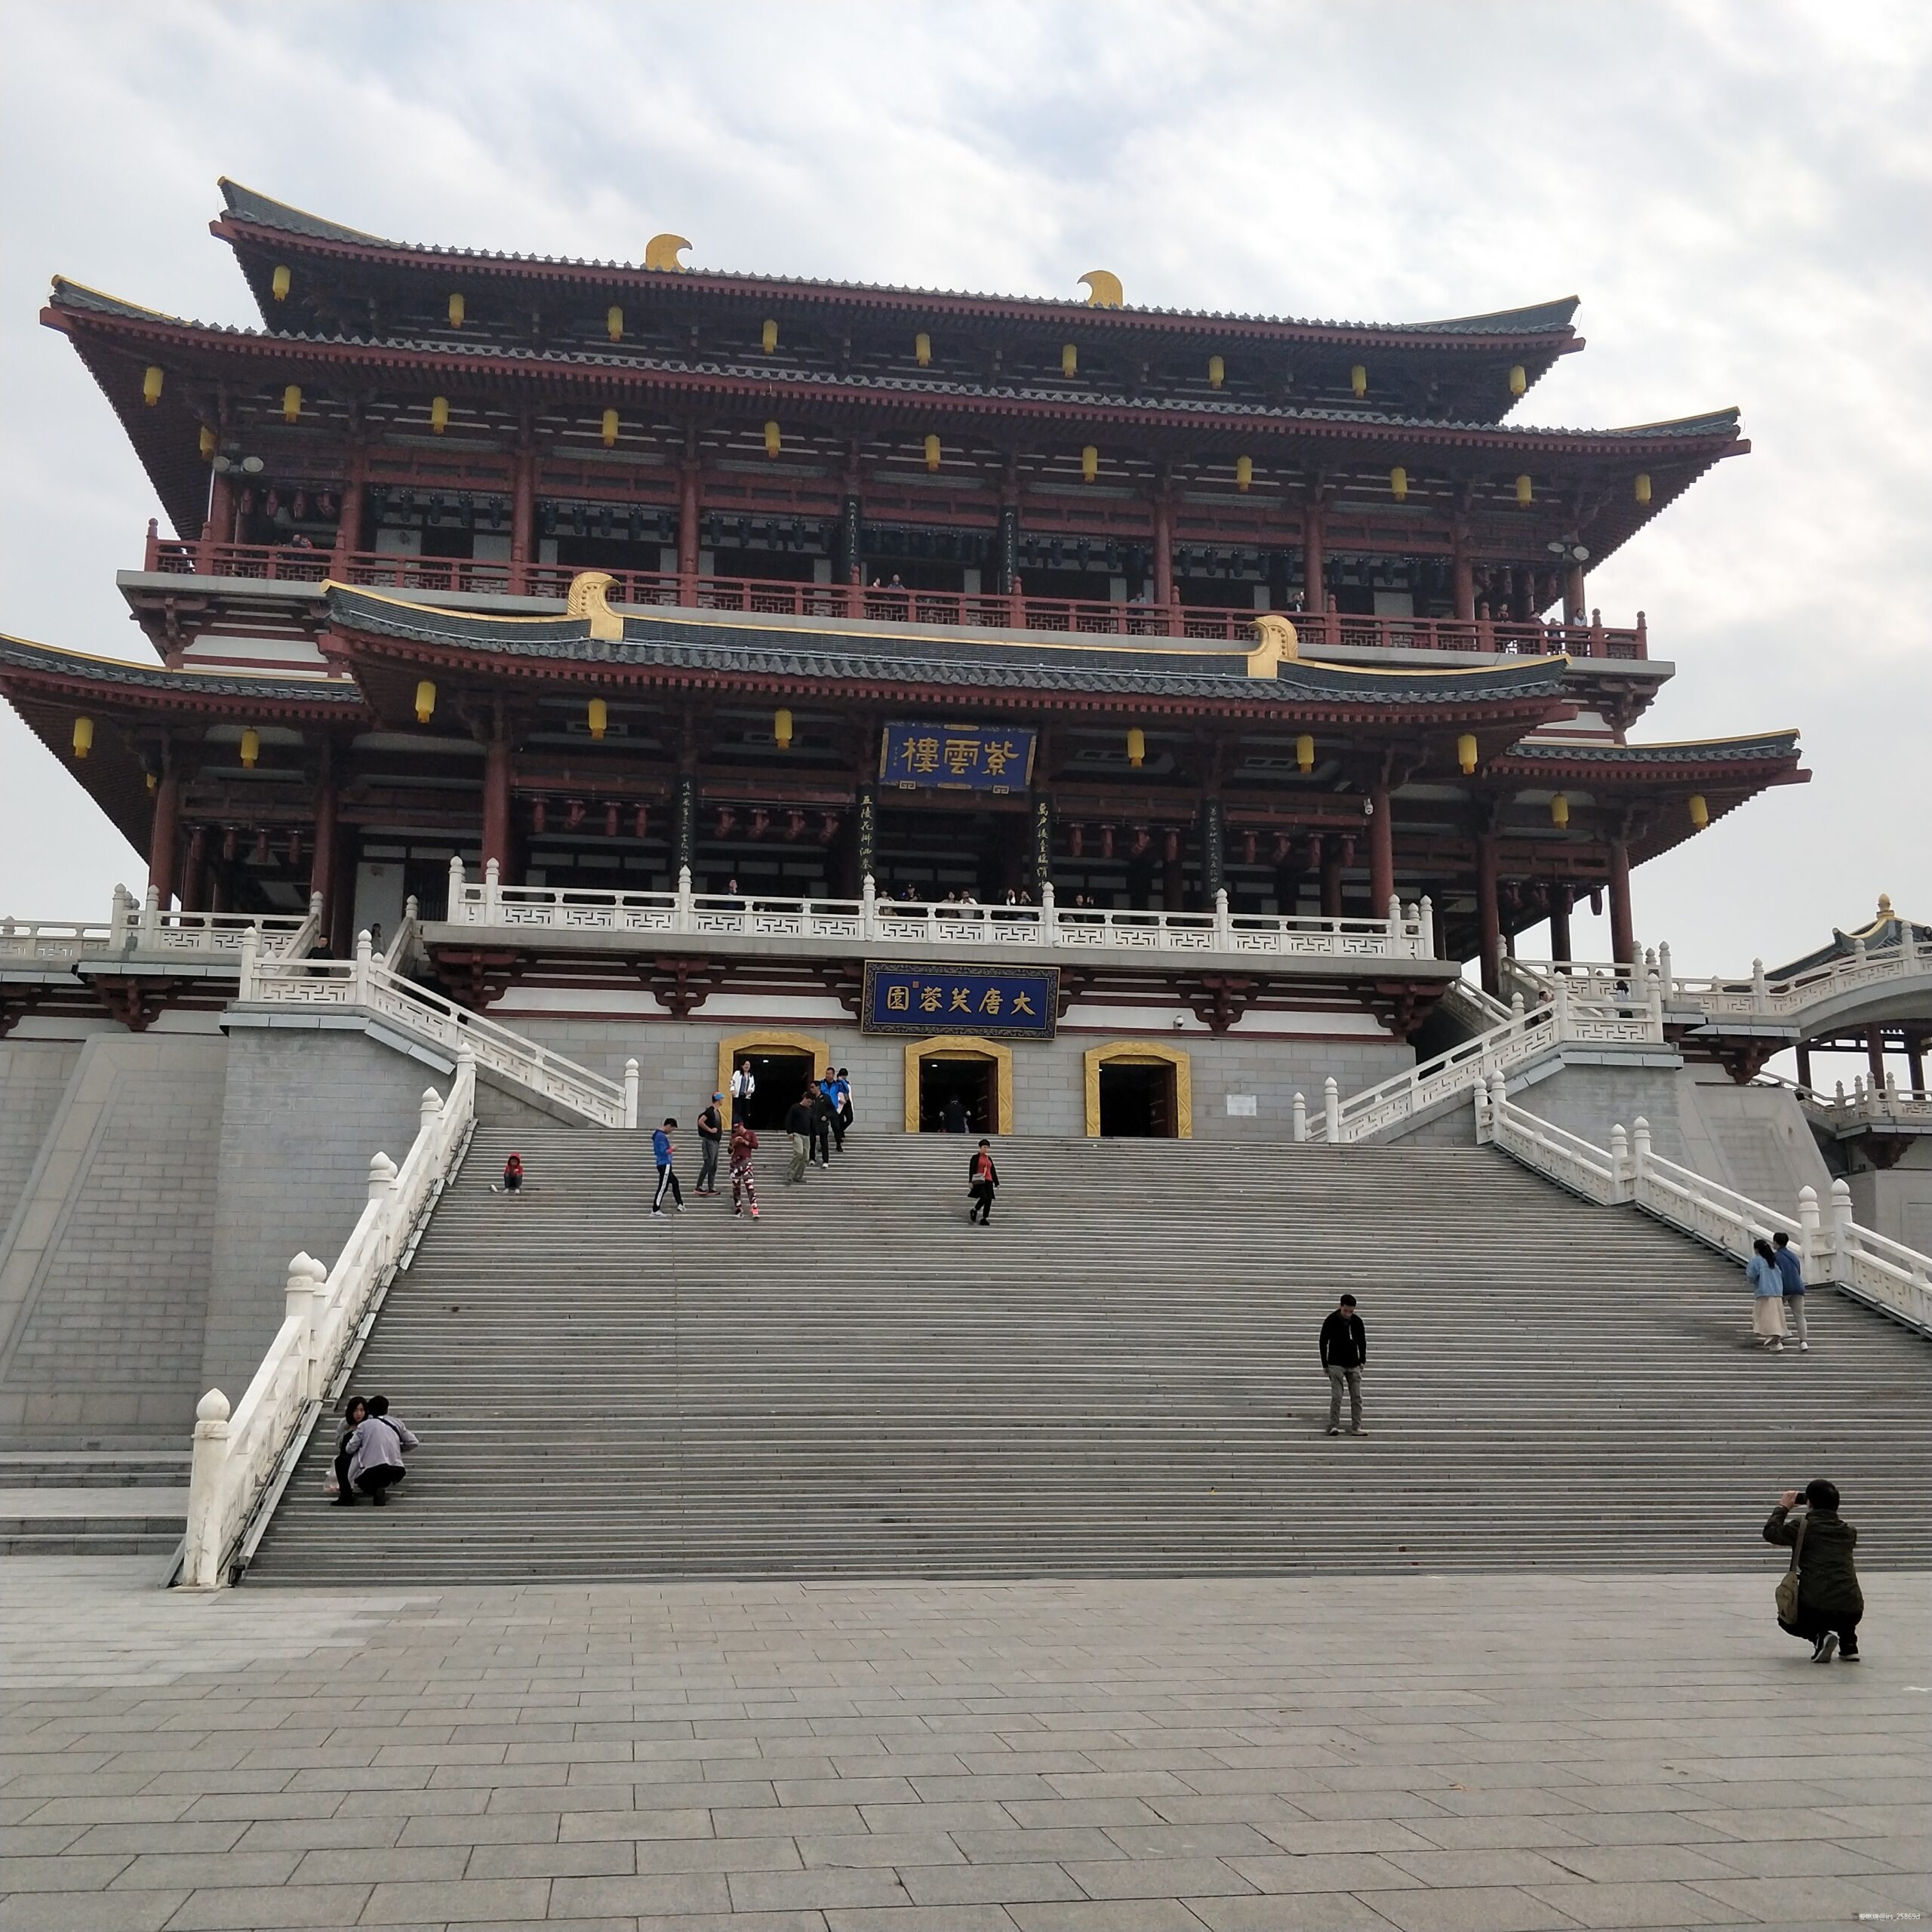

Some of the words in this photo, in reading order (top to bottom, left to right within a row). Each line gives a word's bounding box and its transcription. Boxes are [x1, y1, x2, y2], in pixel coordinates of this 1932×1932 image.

[900, 737, 1020, 776] 紫雲樓
[887, 986, 1036, 1016] 大唐芙蓉園
